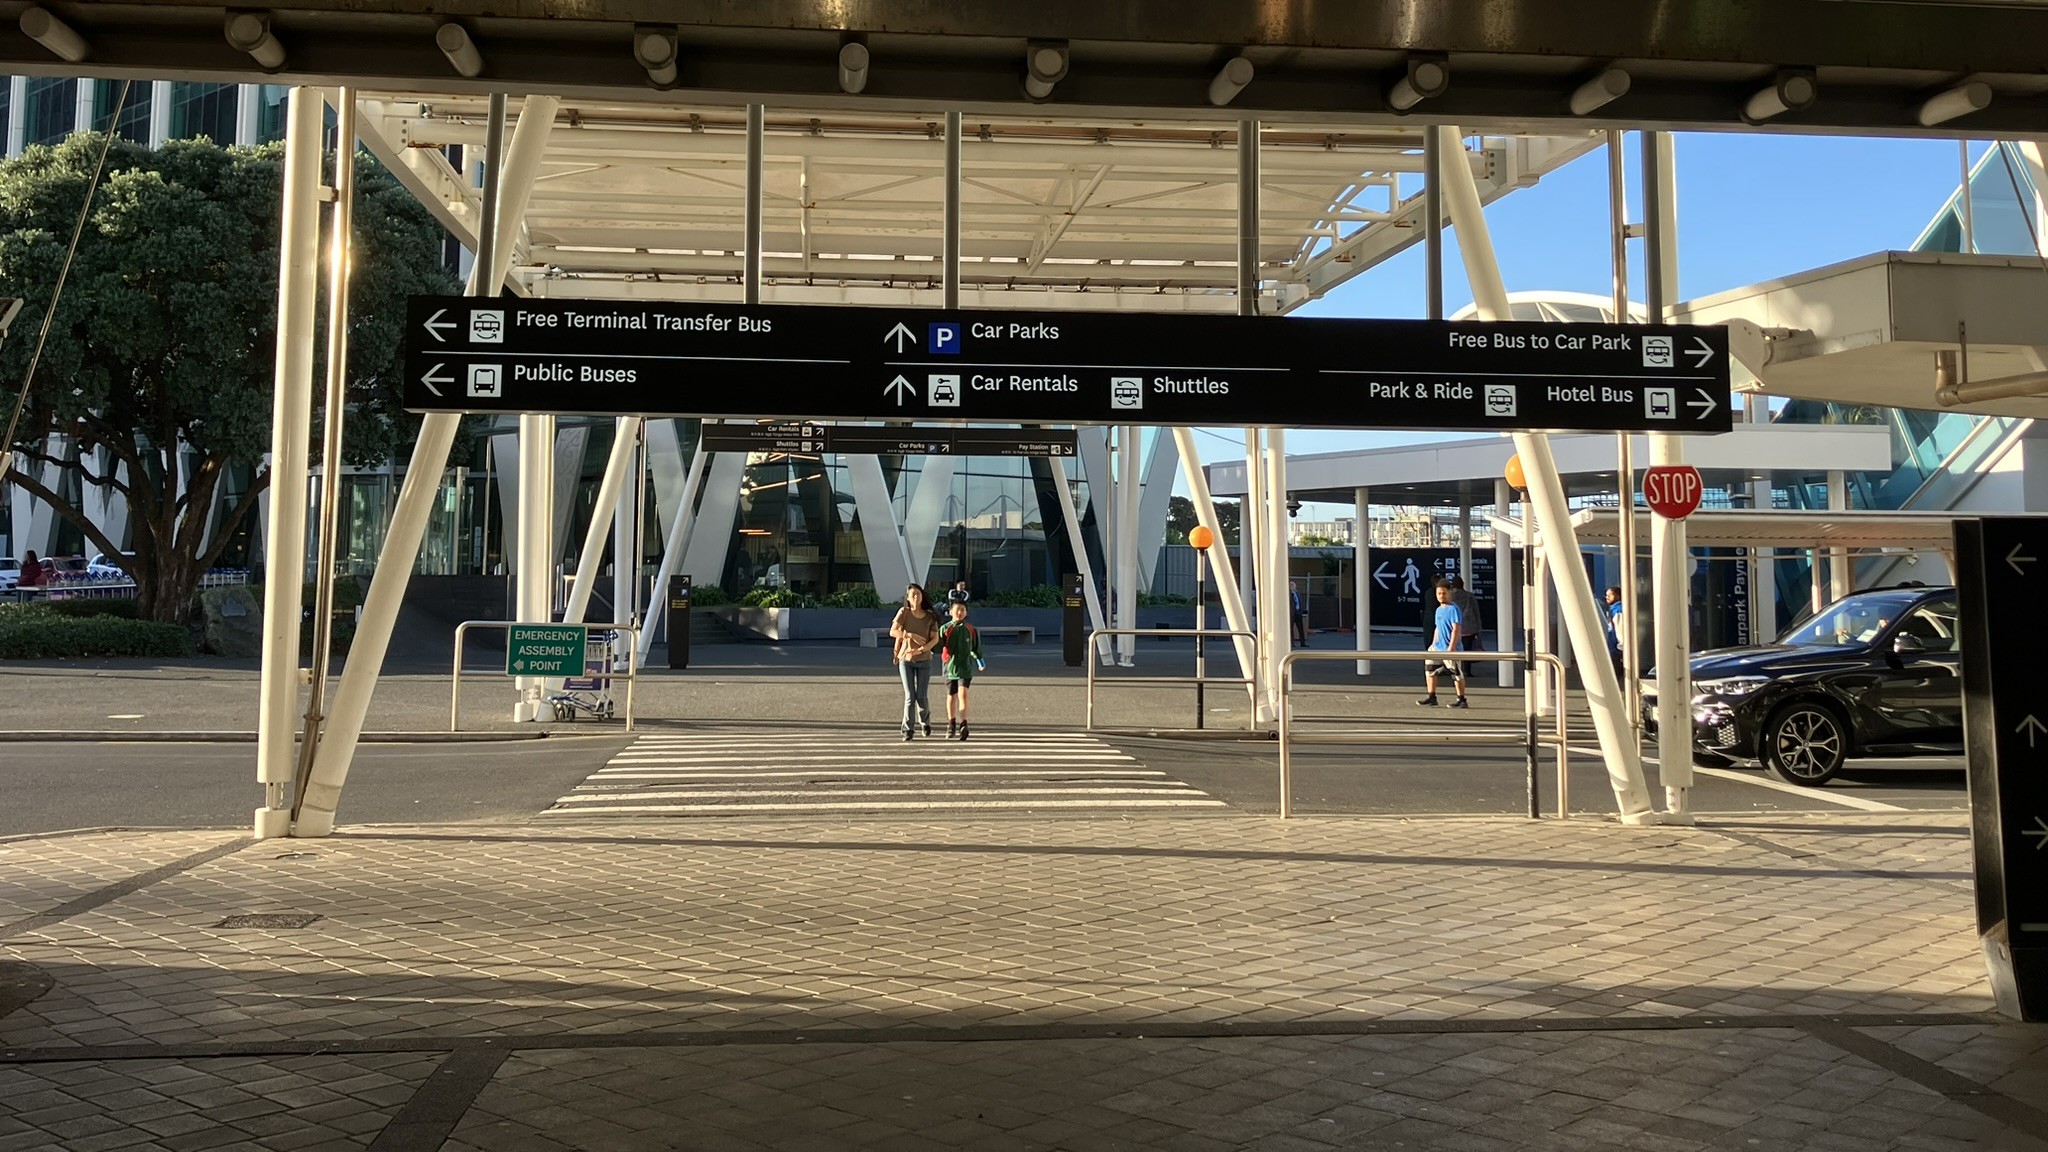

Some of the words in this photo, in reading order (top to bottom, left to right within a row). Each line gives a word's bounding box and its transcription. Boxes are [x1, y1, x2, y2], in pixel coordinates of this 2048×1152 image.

[516, 310, 558, 327] Free
[563, 311, 647, 330] Terminal
[652, 313, 732, 332] Transfer
[738, 316, 772, 333] Bus
[937, 327, 953, 348] P
[971, 322, 1003, 339] Car
[1009, 321, 1060, 340] Parks
[1449, 332, 1487, 348] Free
[1493, 333, 1526, 349] Bus
[1530, 334, 1549, 349] to
[1555, 333, 1586, 350] Car
[1592, 333, 1632, 351] Park
[514, 363, 574, 382] Public
[580, 365, 637, 383] Buses
[971, 374, 1003, 391] Car
[1009, 374, 1079, 392] Rentals
[1153, 375, 1229, 395] Shuttles
[1370, 381, 1410, 398] Park
[1415, 383, 1429, 399] &
[1434, 382, 1473, 400] Ride
[1547, 384, 1596, 402] Hotel
[1601, 386, 1633, 403] Bus
[1648, 474, 1697, 505] STOP
[1734, 547, 1747, 595] Payme
[1734, 599, 1749, 646] arpark
[515, 631, 580, 641] EMERGENCY
[518, 646, 575, 656] ASSEMBLY
[529, 660, 563, 671] POINT
